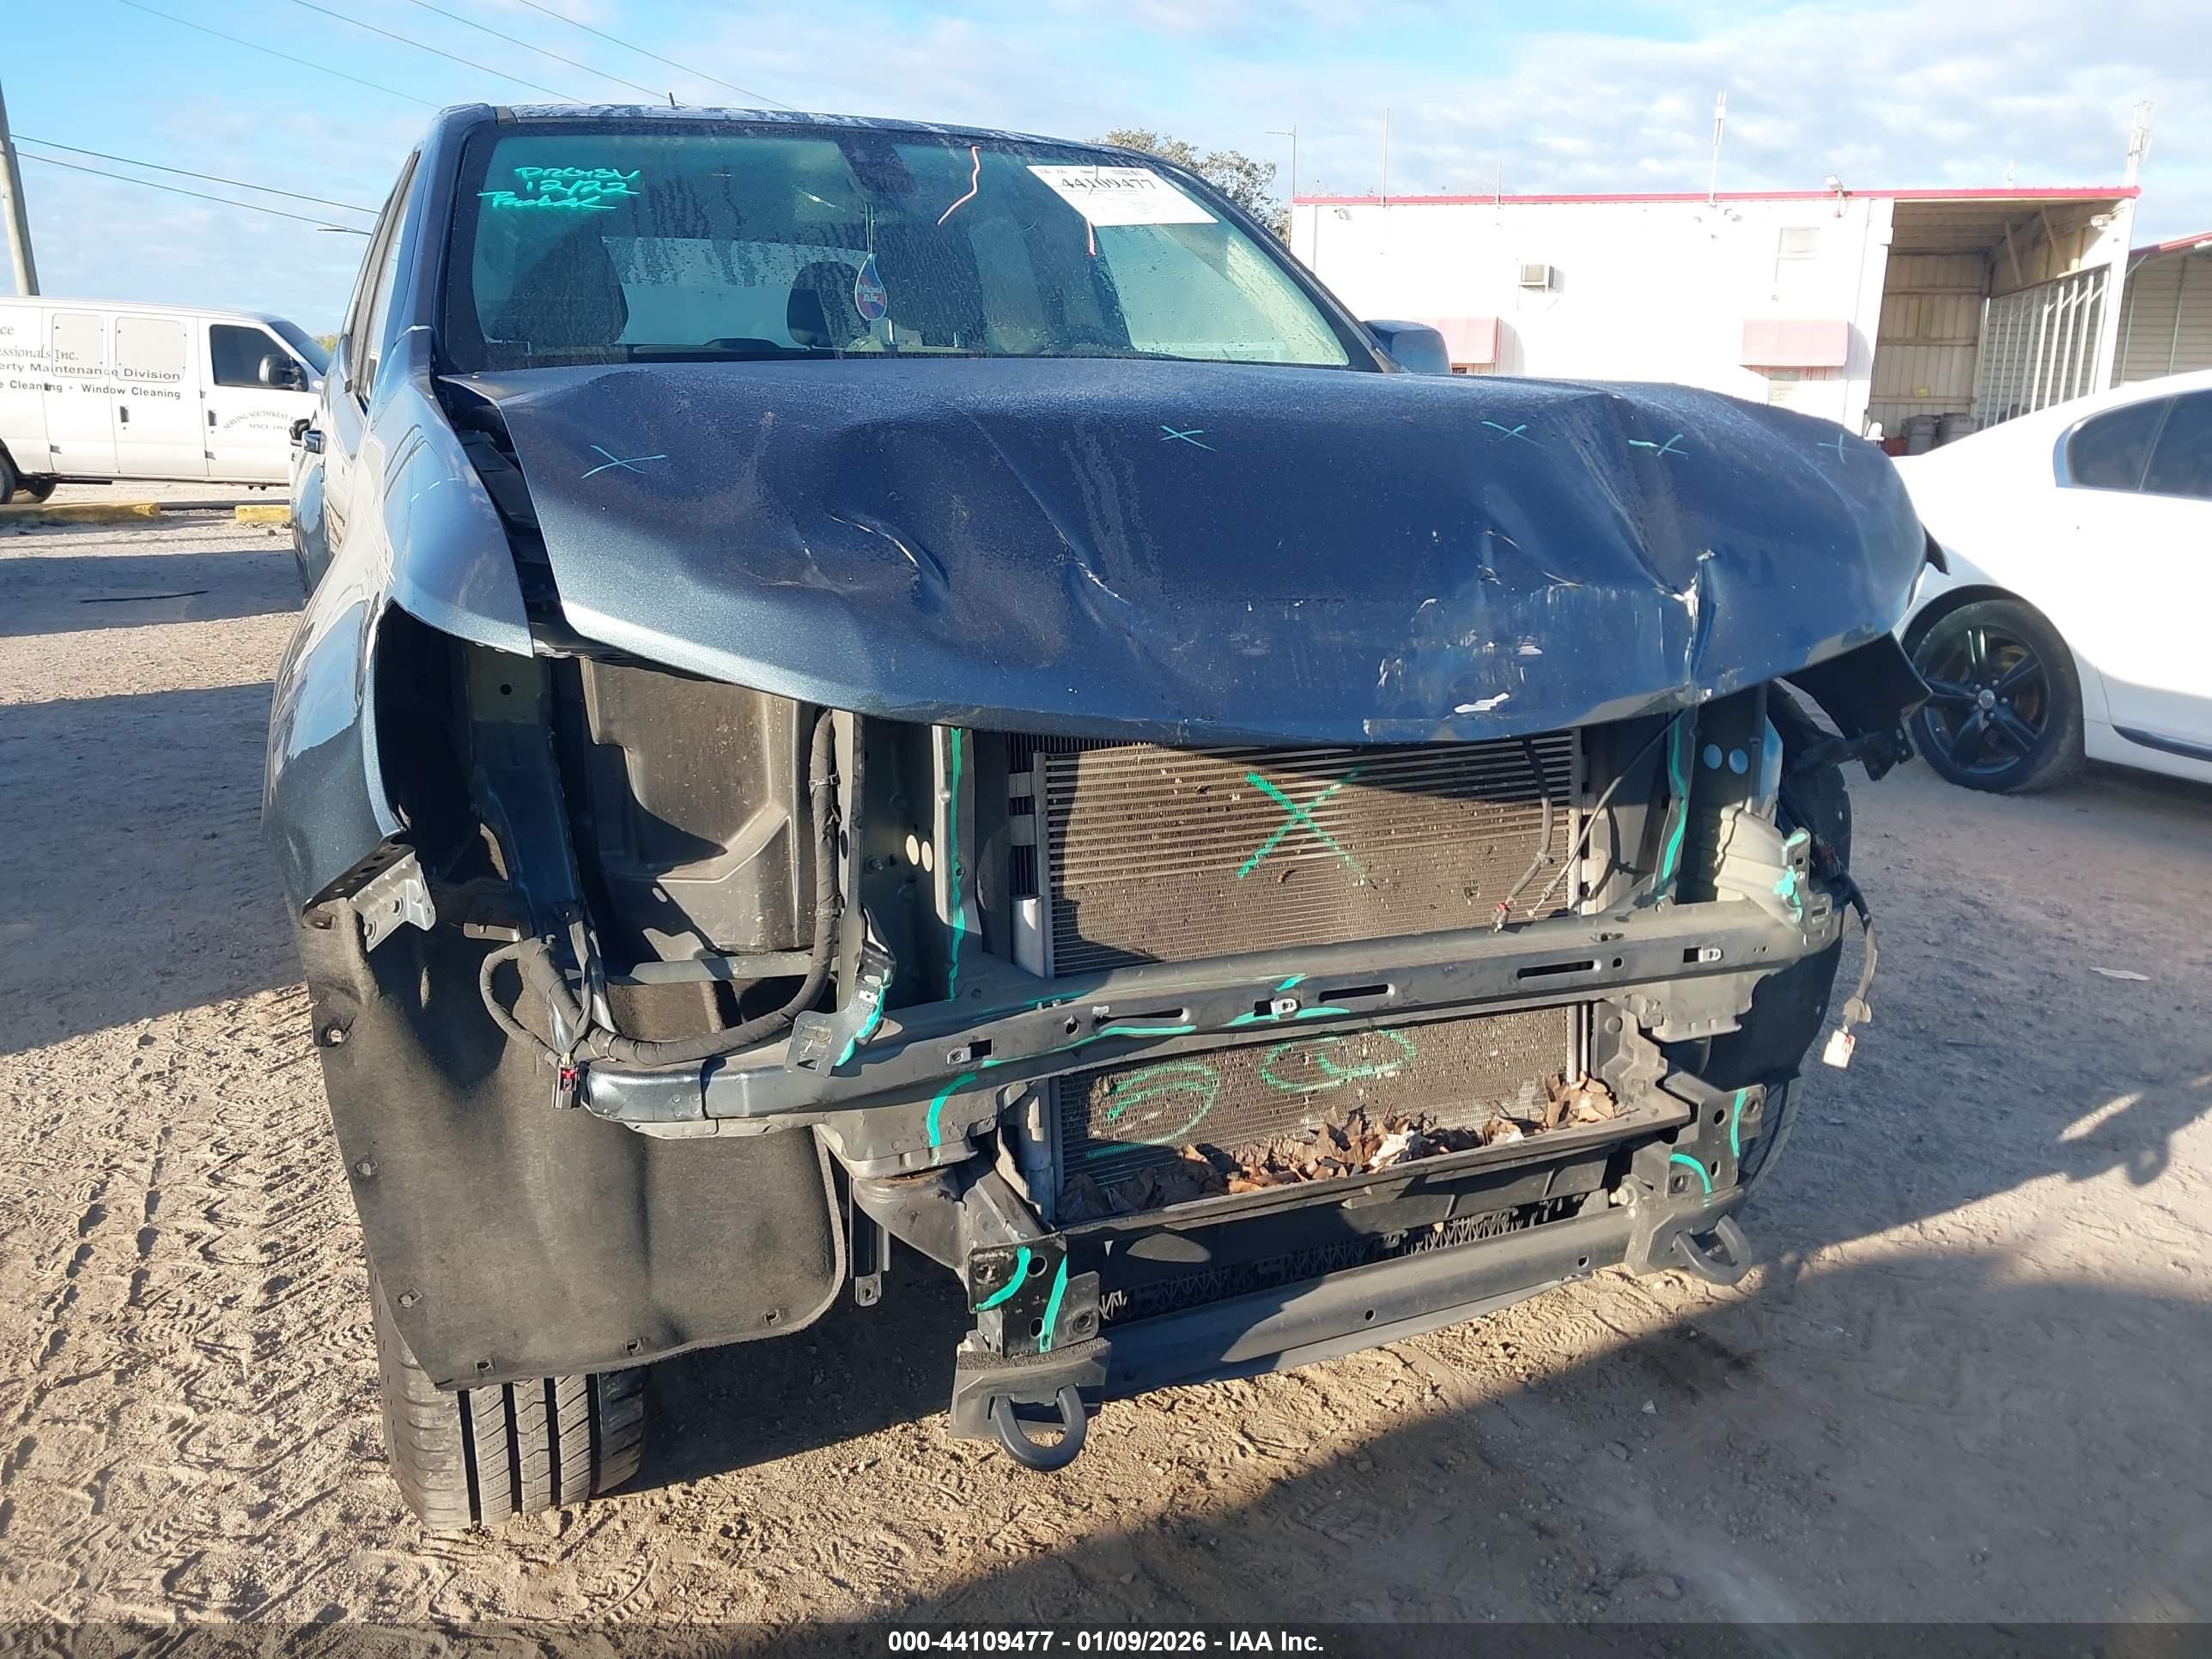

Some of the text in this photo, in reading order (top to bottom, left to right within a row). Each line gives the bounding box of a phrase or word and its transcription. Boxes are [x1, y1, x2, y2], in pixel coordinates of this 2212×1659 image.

[54, 349, 79, 361] Inc.
[30, 363, 118, 377] Maintenance
[124, 368, 180, 380] Division
[9, 380, 63, 392] Cleanng
[82, 383, 125, 395] Window
[131, 387, 180, 400] Cleaning
